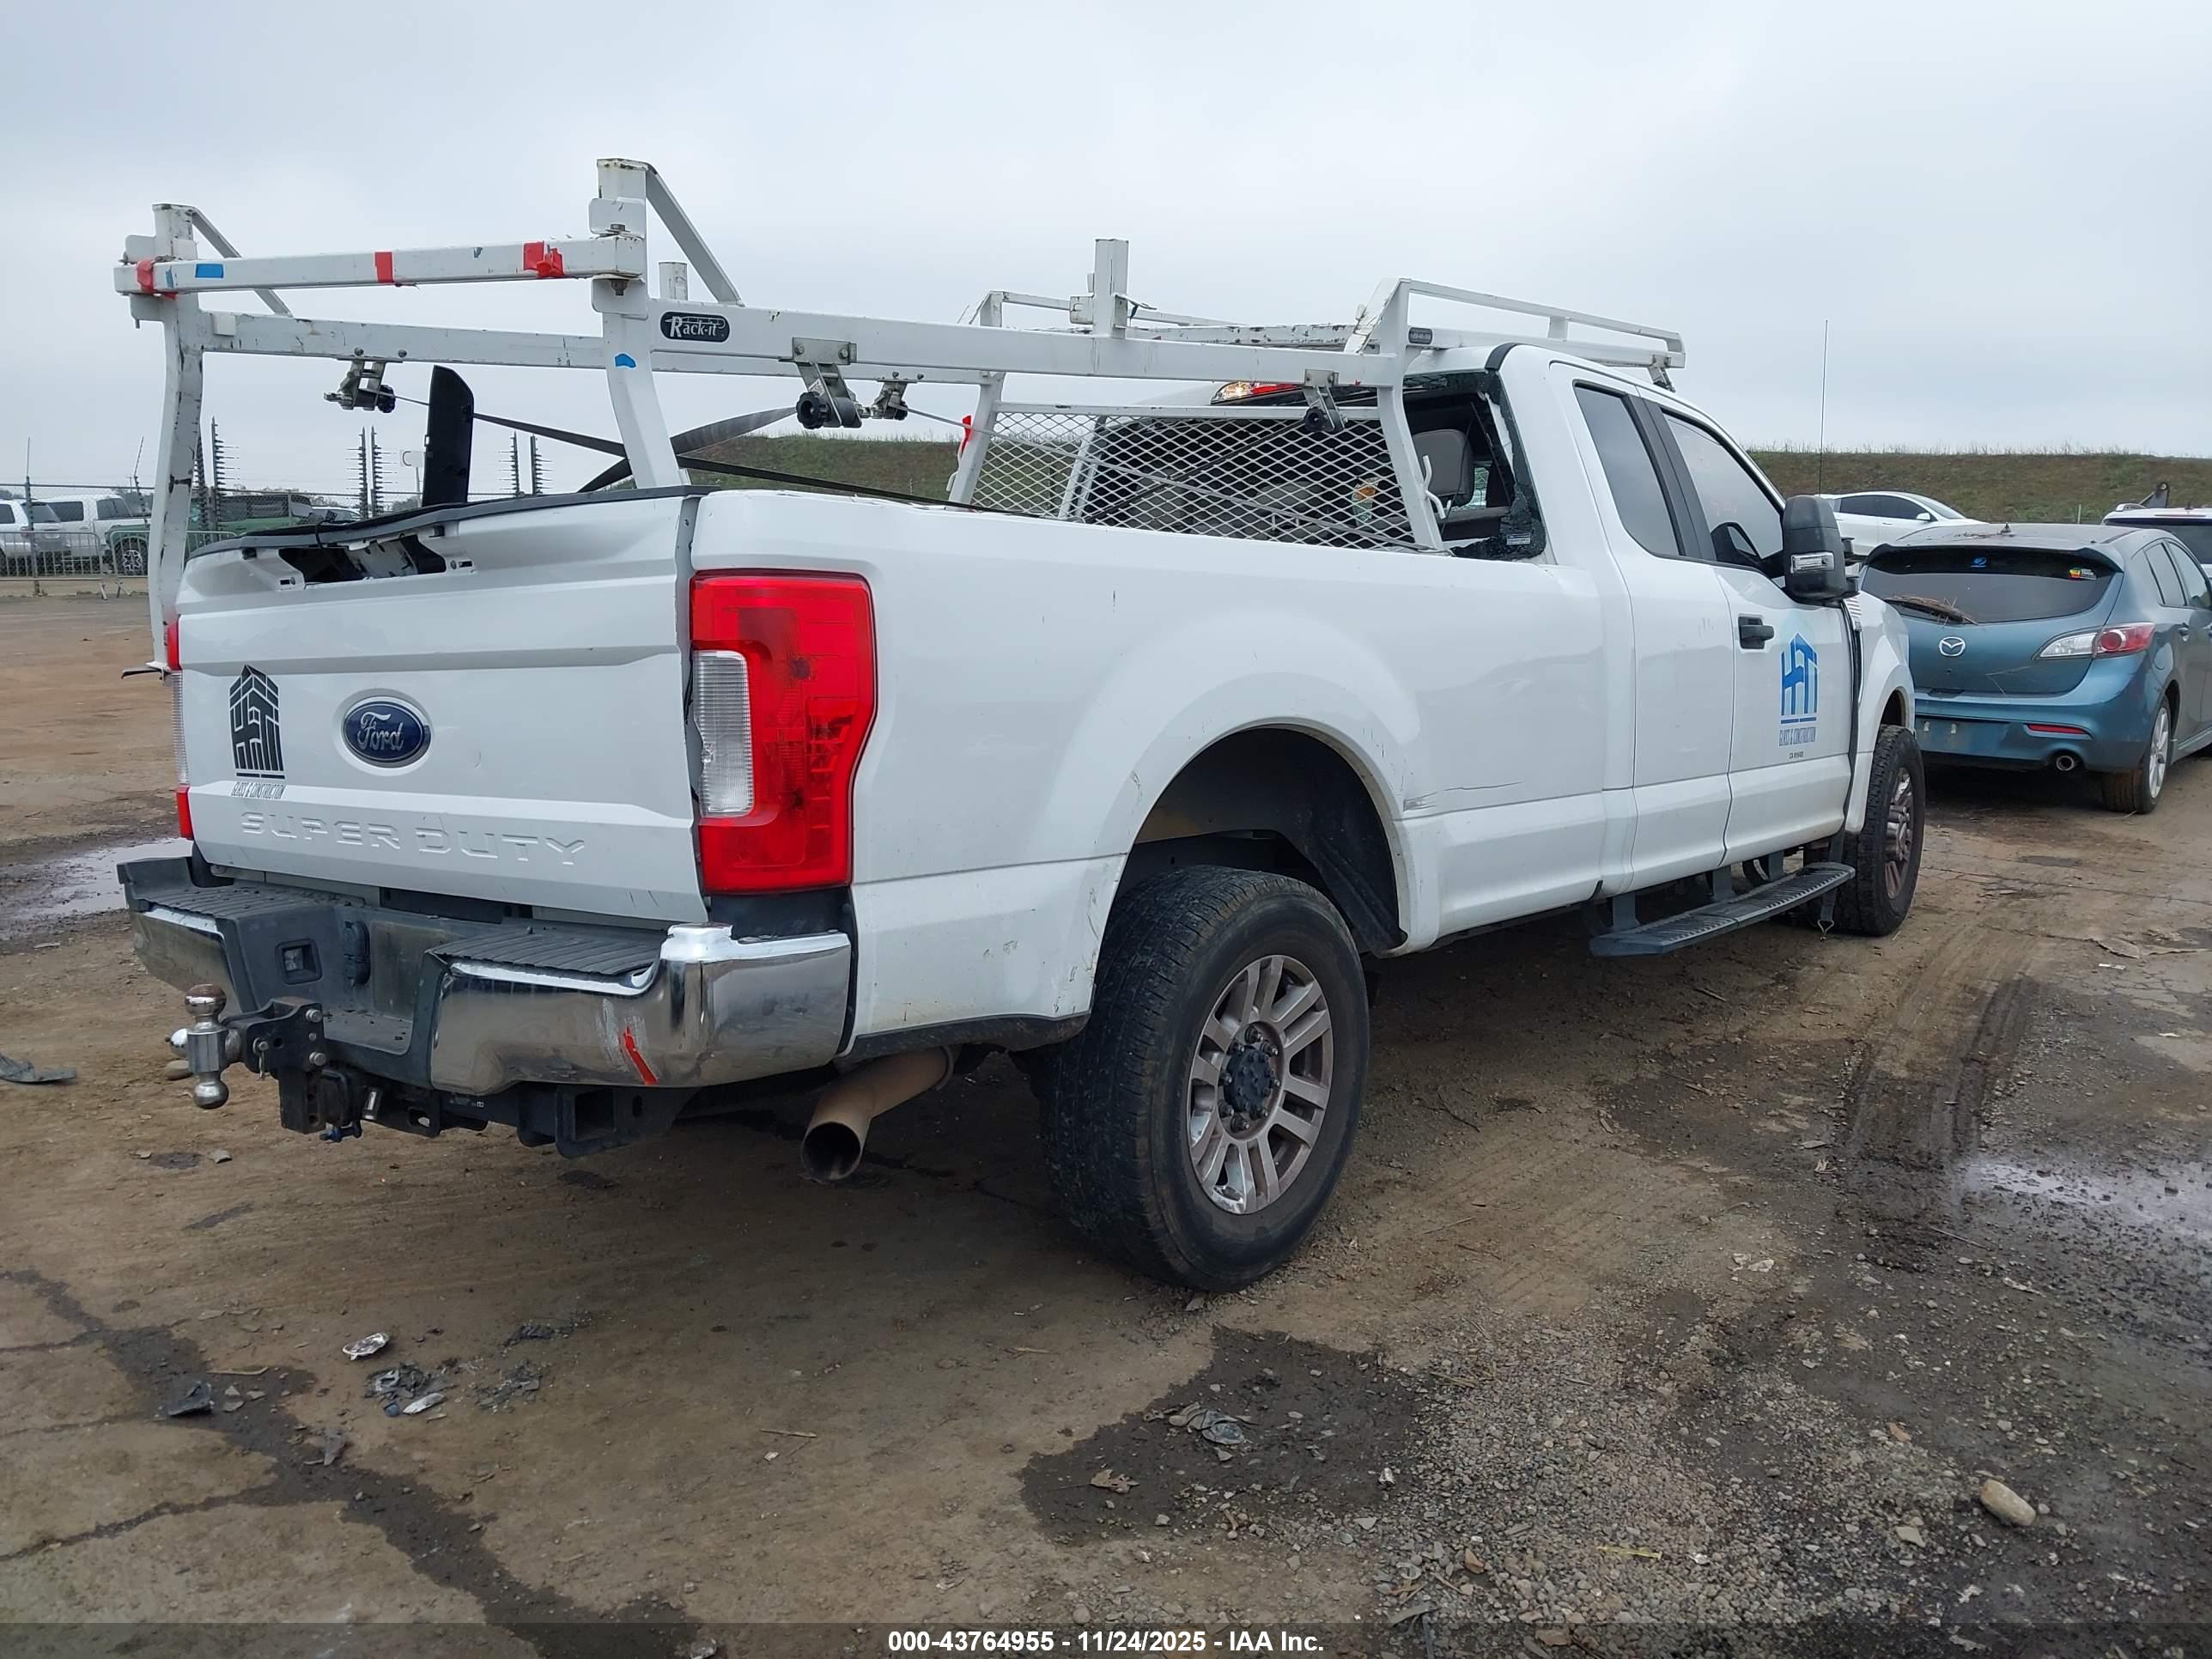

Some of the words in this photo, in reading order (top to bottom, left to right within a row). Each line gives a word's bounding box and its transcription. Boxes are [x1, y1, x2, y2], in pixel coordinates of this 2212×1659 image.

[669, 315, 717, 338] Rack-it
[356, 711, 404, 751] Ford
[241, 811, 401, 850] SUPER
[416, 827, 585, 866] DUTY
